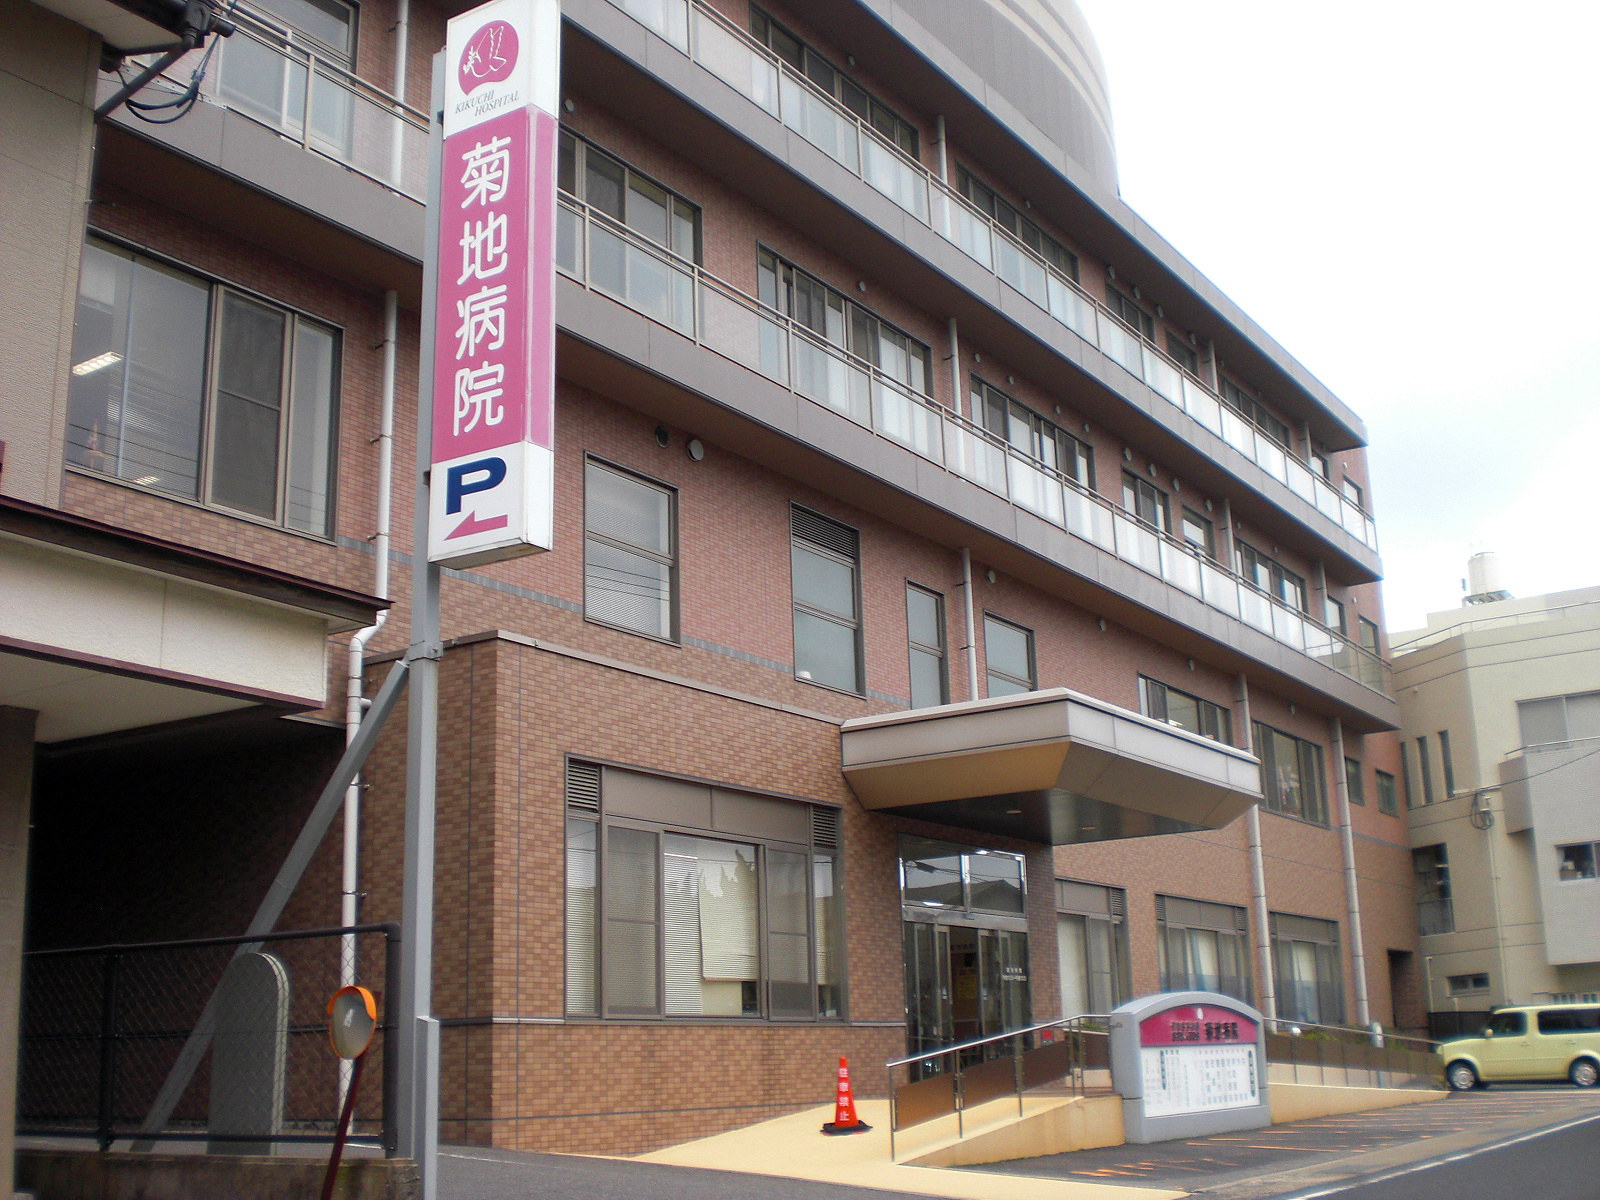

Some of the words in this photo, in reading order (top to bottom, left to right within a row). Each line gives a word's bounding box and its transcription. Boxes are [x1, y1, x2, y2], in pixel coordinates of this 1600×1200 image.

[455, 89, 495, 114] KIKUCHI
[474, 90, 520, 117] HOSPITAL
[453, 136, 512, 437] 菊地病院
[446, 456, 507, 516] P
